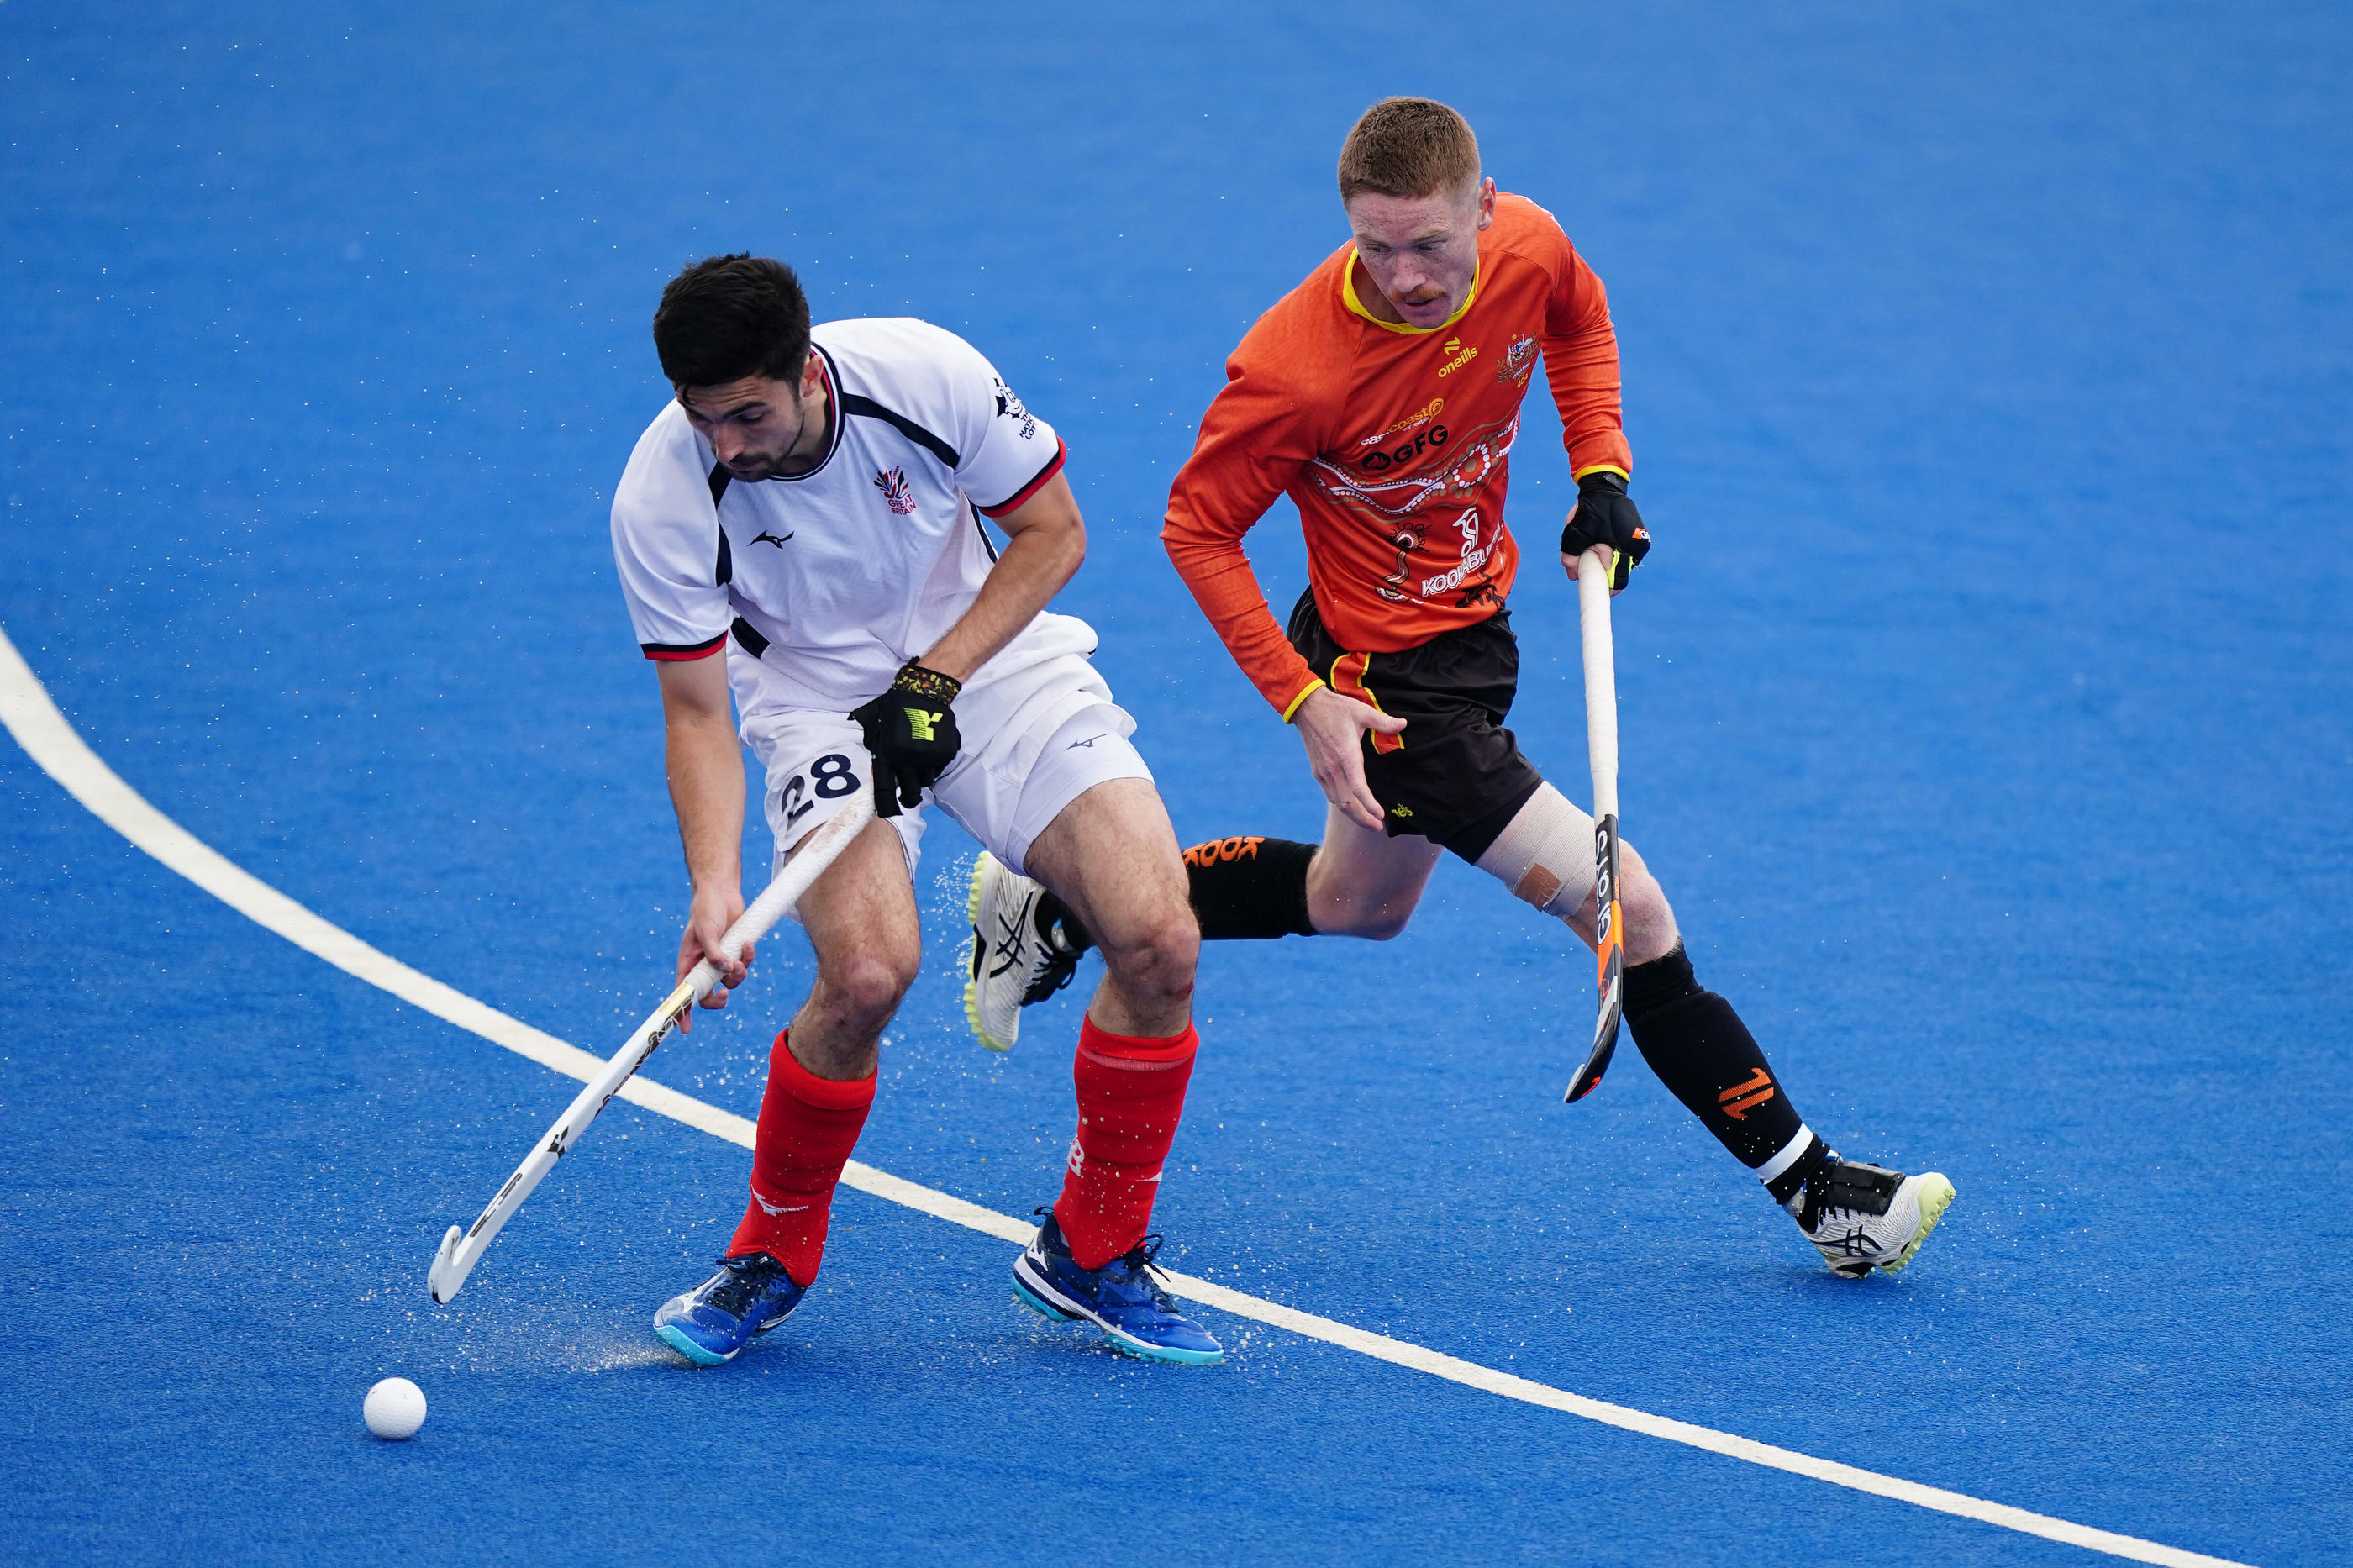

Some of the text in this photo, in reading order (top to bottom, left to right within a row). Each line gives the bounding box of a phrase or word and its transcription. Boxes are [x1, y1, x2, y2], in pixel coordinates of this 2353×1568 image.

[1393, 425, 1448, 463] GFG
[888, 494, 912, 508] GREAT
[891, 502, 917, 515] BRITAIN
[782, 754, 861, 832] 28
